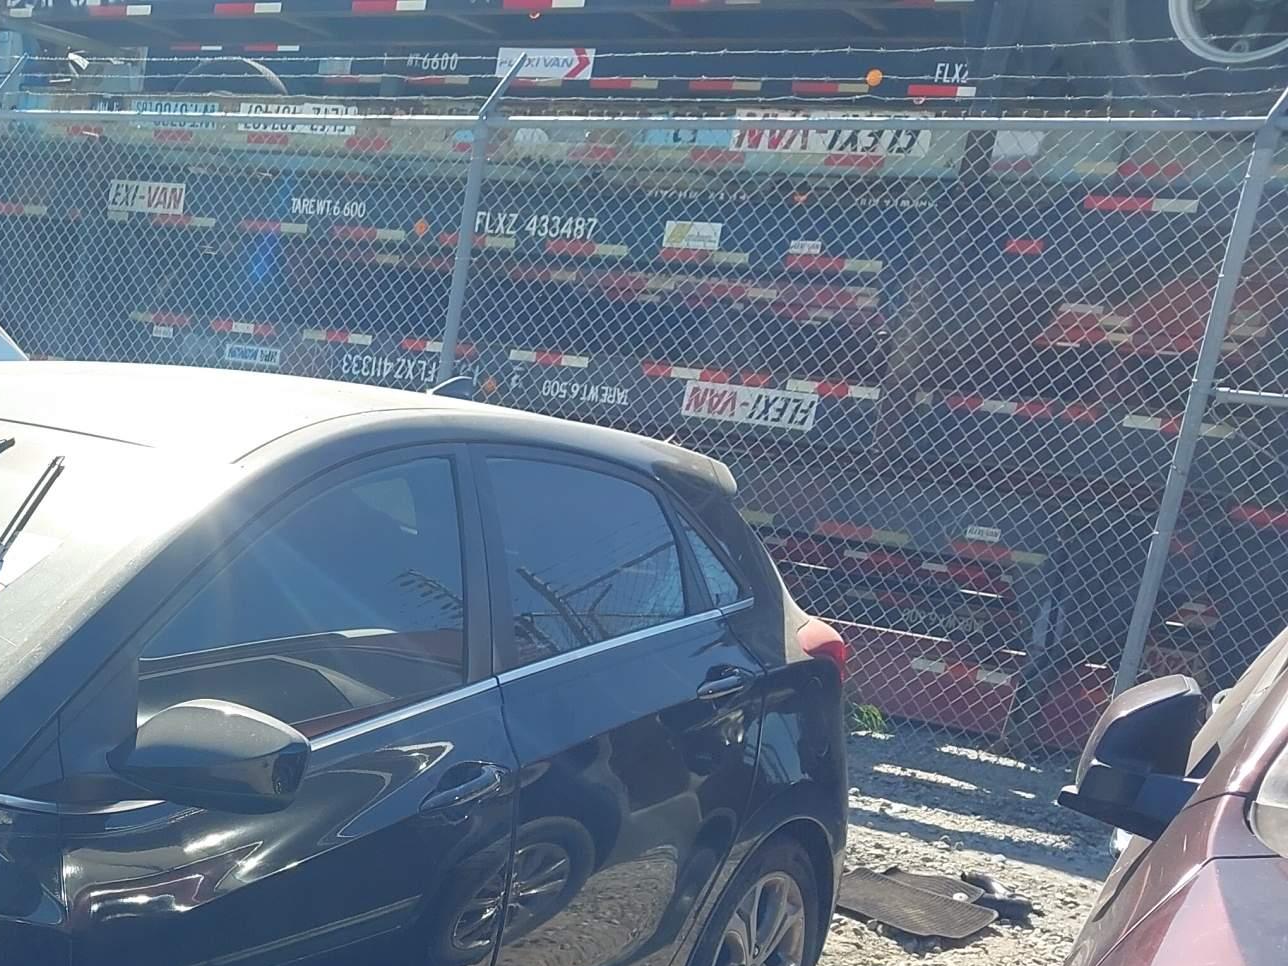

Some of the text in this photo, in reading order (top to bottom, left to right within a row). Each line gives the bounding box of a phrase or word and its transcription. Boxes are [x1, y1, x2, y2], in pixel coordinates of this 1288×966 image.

[422, 52, 458, 71] 6600
[474, 211, 598, 240] FLXZ 433487
[685, 386, 815, 426] FLEXI-VAN
